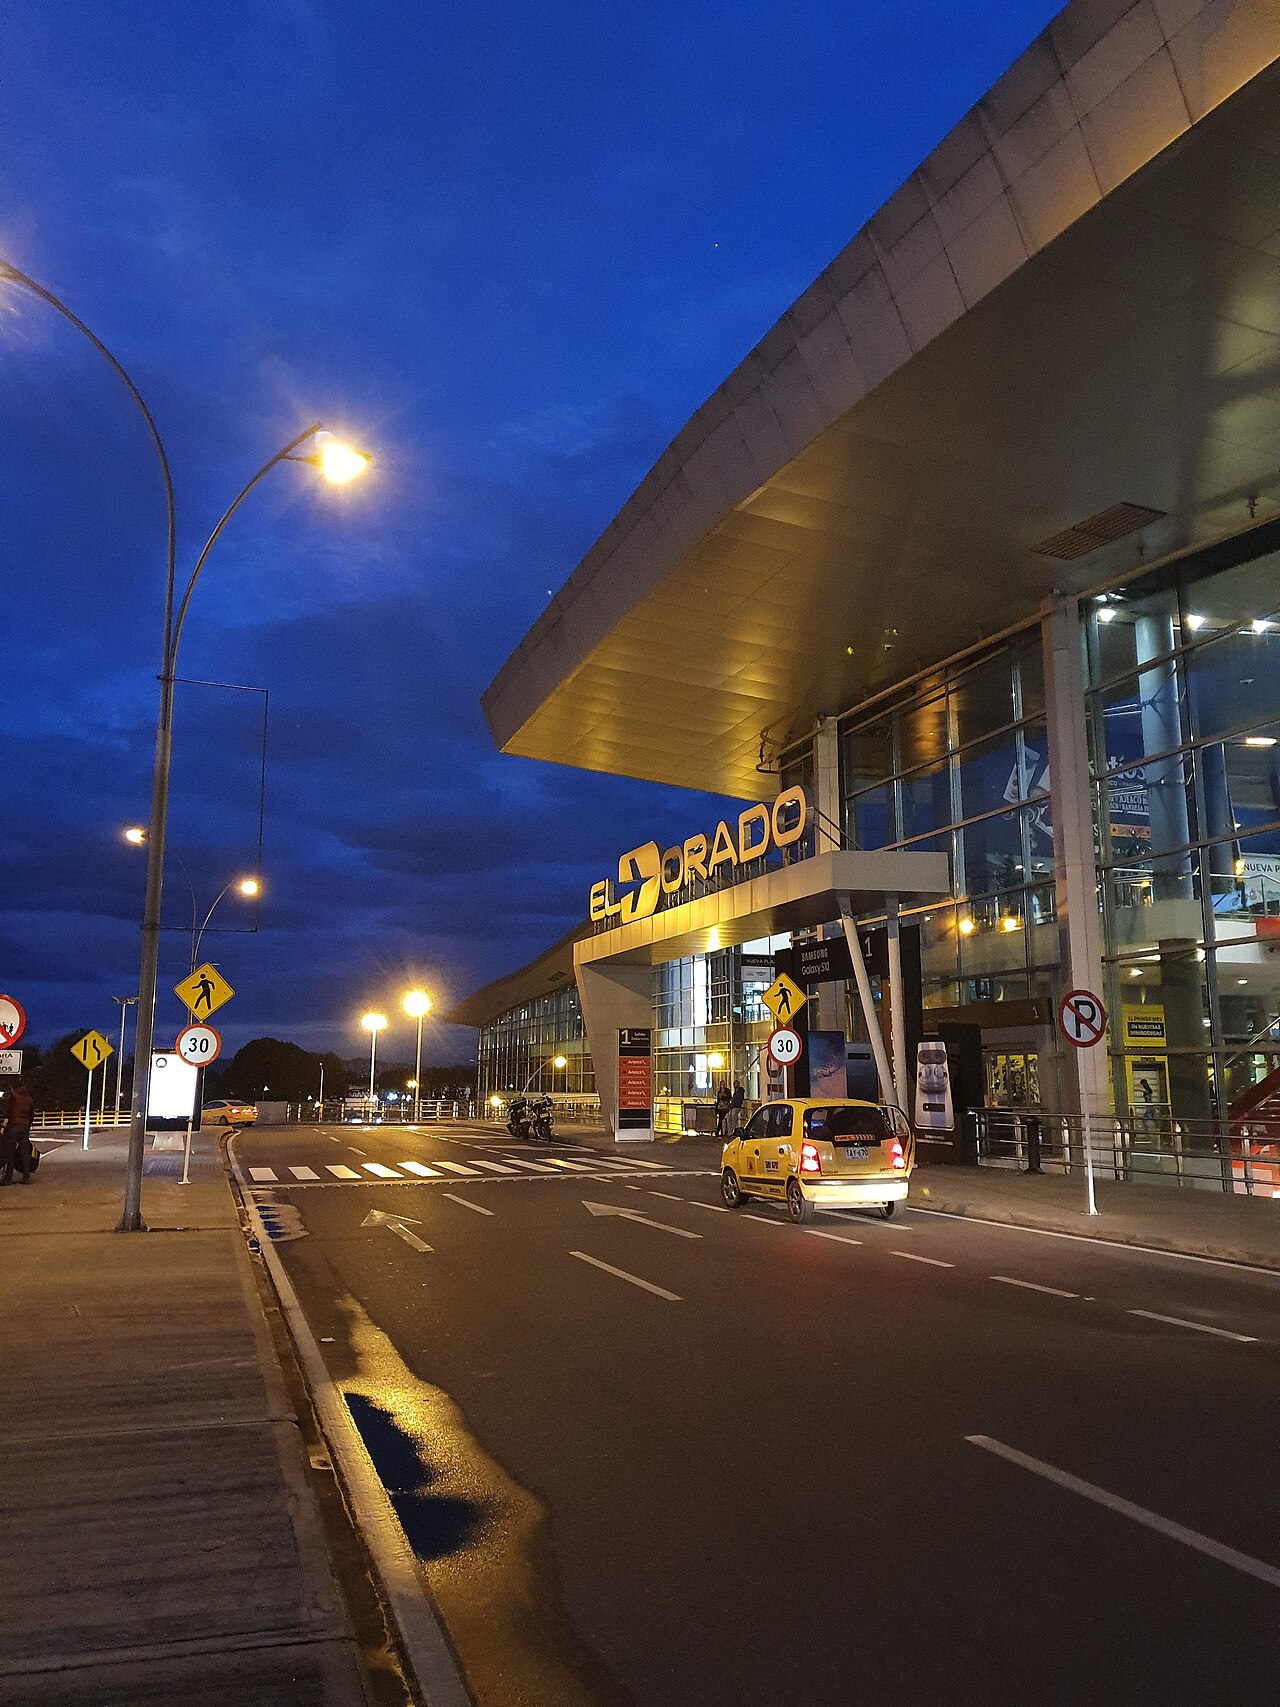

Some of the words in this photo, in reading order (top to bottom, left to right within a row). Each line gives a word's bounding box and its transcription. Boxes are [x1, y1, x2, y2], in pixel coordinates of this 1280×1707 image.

[1244, 863, 1273, 872] NUEVA
[589, 878, 621, 921] EL
[801, 947, 828, 962] SAMSUNG
[864, 936, 873, 957] 1
[801, 964, 821, 976] Galaxy
[821, 961, 830, 972] S10
[1074, 1000, 1096, 1038] P
[188, 1037, 209, 1053] 30
[621, 1029, 631, 1045] 1
[777, 1039, 793, 1053] 30
